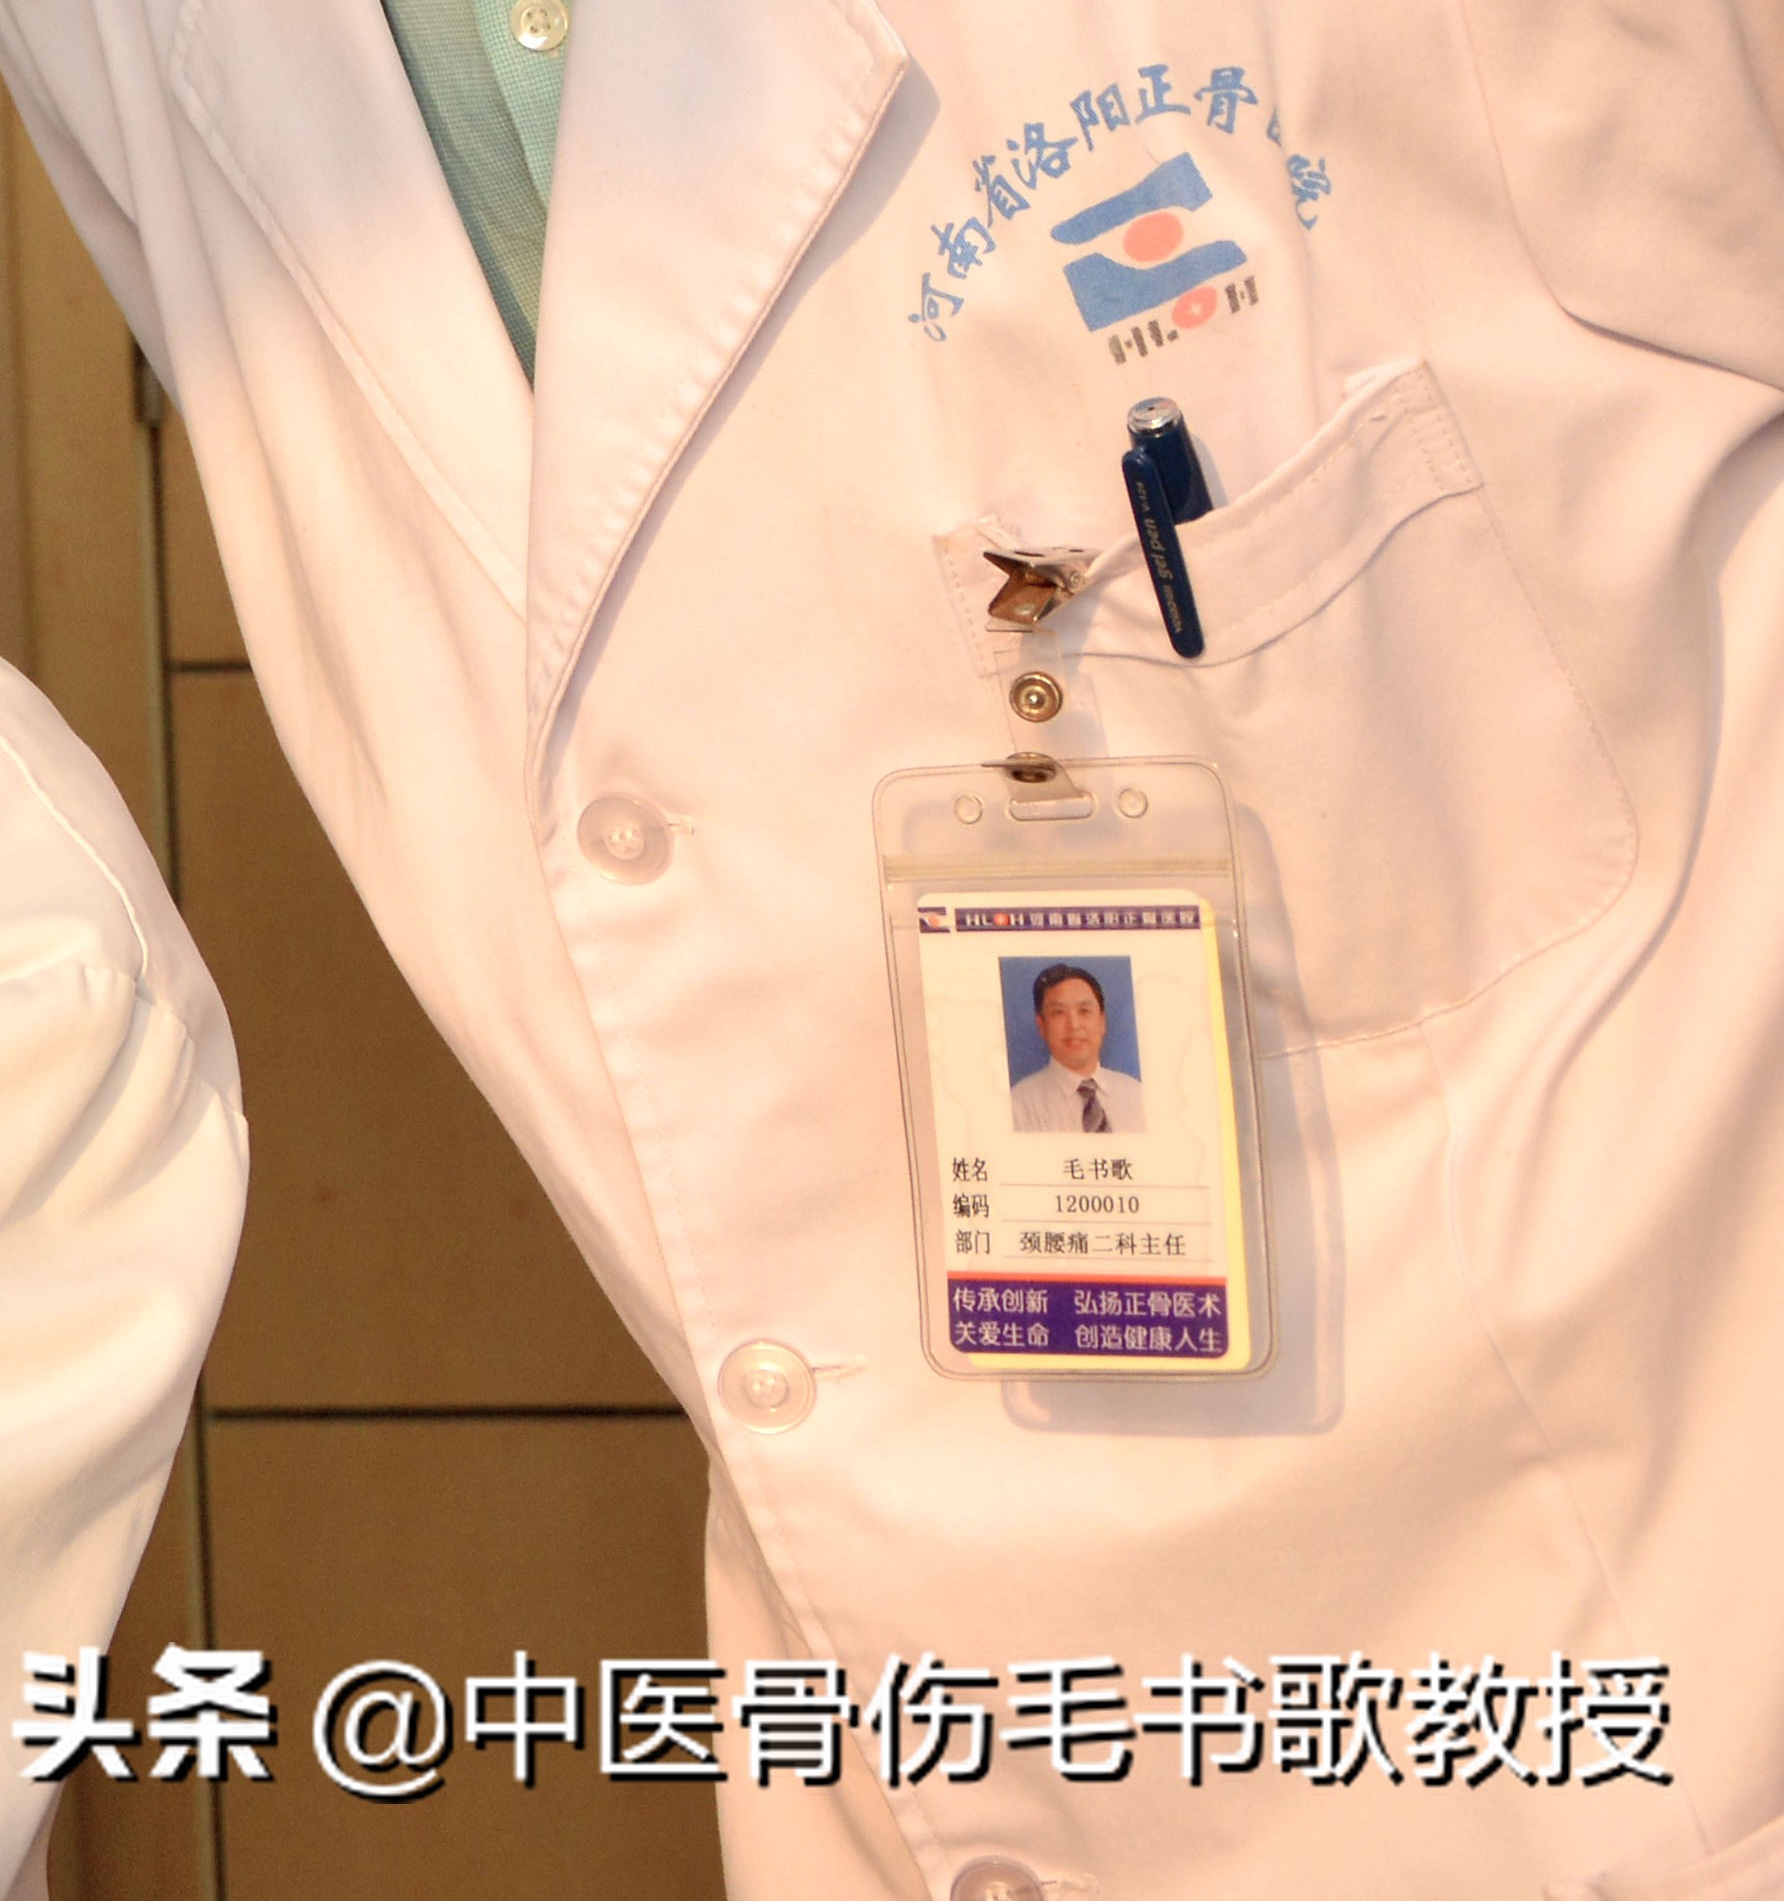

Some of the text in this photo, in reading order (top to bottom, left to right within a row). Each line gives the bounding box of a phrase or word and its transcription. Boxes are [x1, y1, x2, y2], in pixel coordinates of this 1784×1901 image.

[908, 64, 1331, 342] 河南省洛阳正骨院
[1144, 518, 1165, 553] pen
[951, 1156, 1134, 1183] 姓名 毛书歌
[952, 1192, 1140, 1219] 编码 1200010
[954, 1229, 1187, 1256] 部门 颈腰痛二科主任
[952, 1286, 1223, 1318] 传承创新 弘扬正骨医术
[954, 1321, 1223, 1353] 关爱生命 创造健康人生
